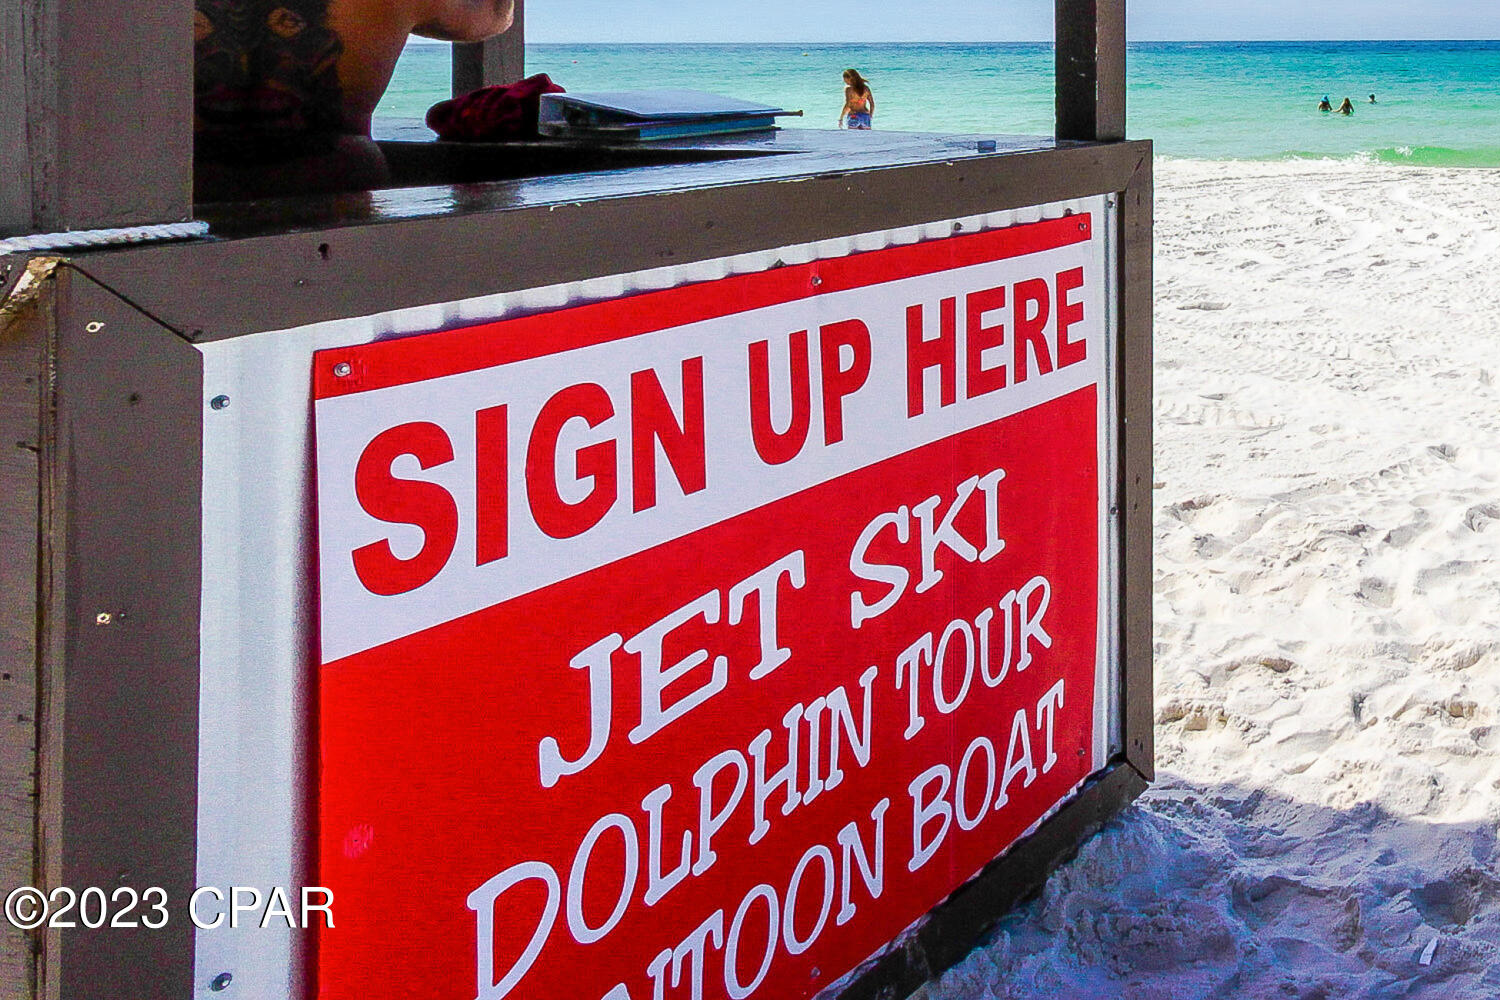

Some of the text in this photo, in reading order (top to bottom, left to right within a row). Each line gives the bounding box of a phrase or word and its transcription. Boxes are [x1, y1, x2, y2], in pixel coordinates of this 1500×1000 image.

[351, 266, 1087, 597] SIGN UP HERE
[465, 576, 1053, 1000] DOLPHIN TOUR
[538, 469, 1006, 788] JET SKI
[909, 679, 1066, 872] BOAT
